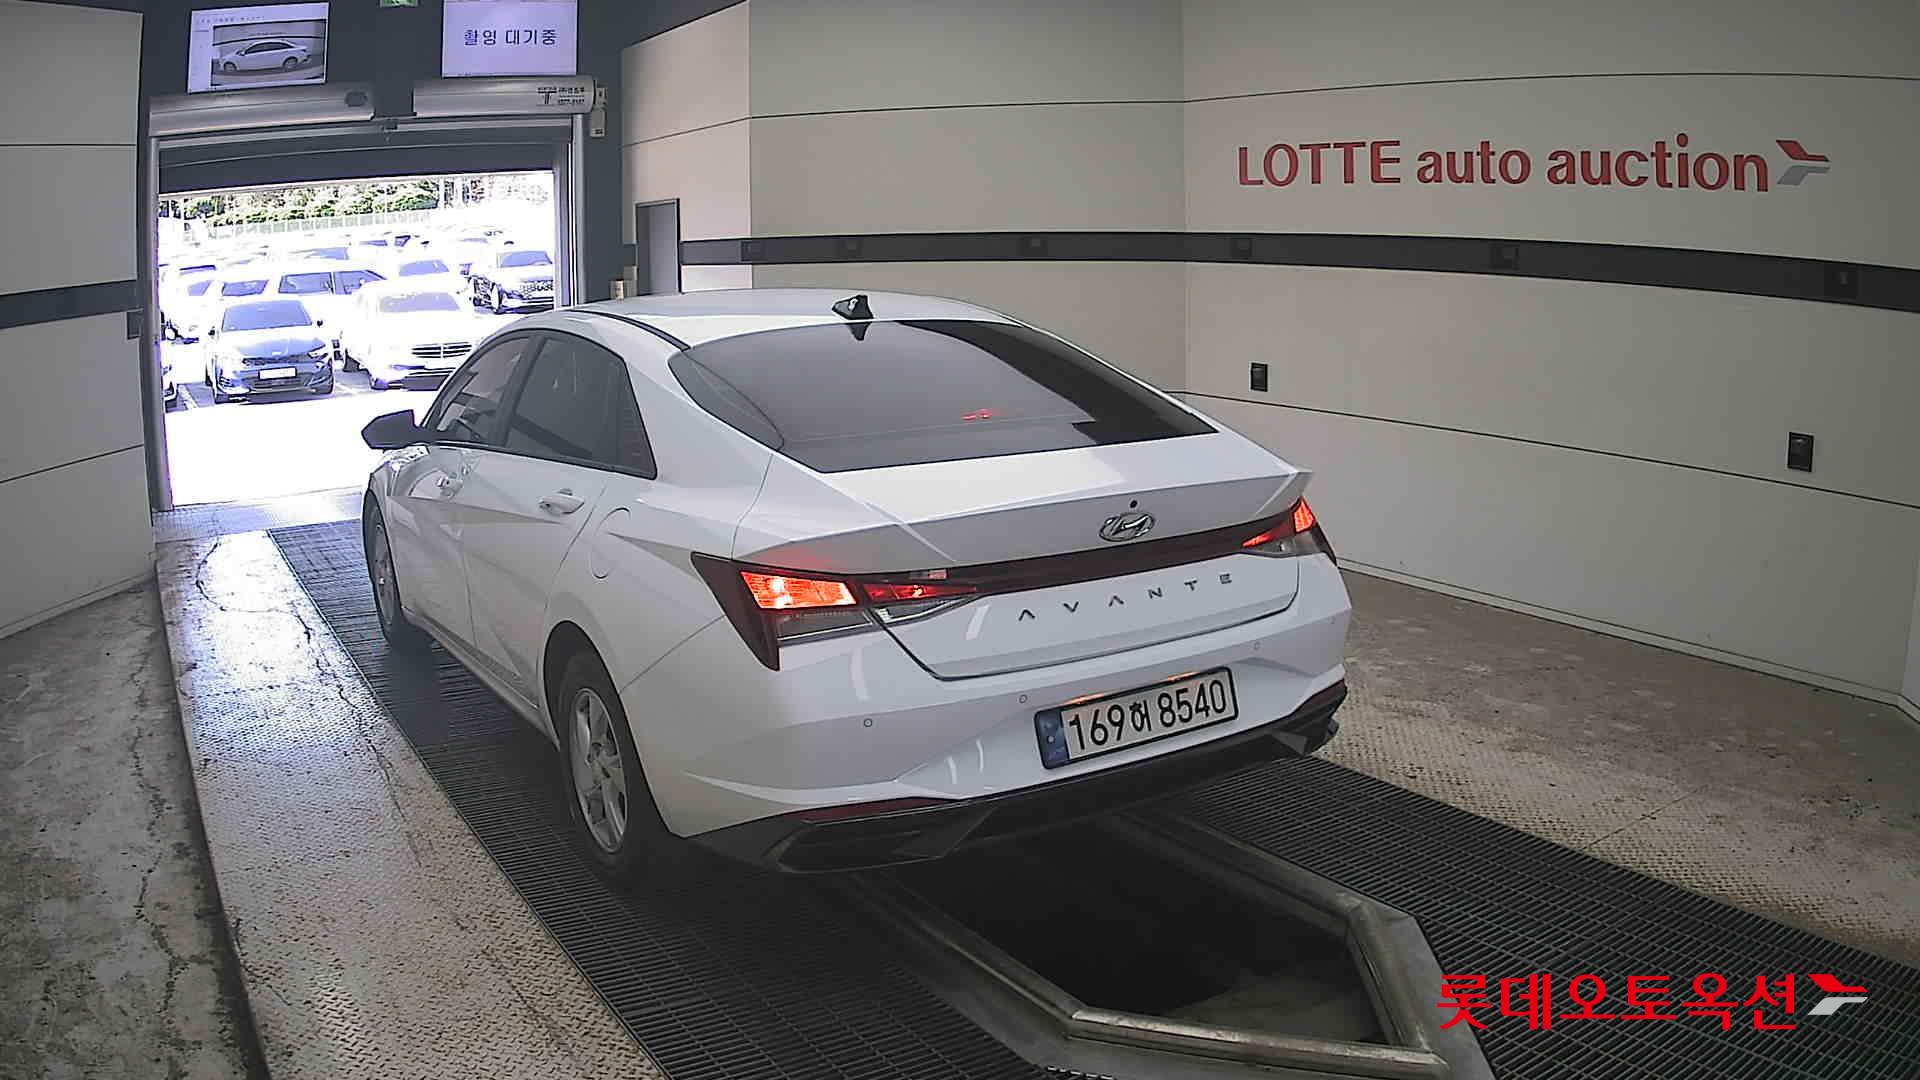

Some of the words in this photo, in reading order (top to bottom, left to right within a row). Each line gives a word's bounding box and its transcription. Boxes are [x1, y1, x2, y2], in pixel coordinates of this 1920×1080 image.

[505, 29, 557, 46] 대기중
[1238, 139, 1401, 187] LOTTE
[1416, 140, 1532, 185] auto
[1546, 132, 1769, 192] auction
[1018, 573, 1233, 622] AVANTE
[1157, 679, 1227, 728] 8540
